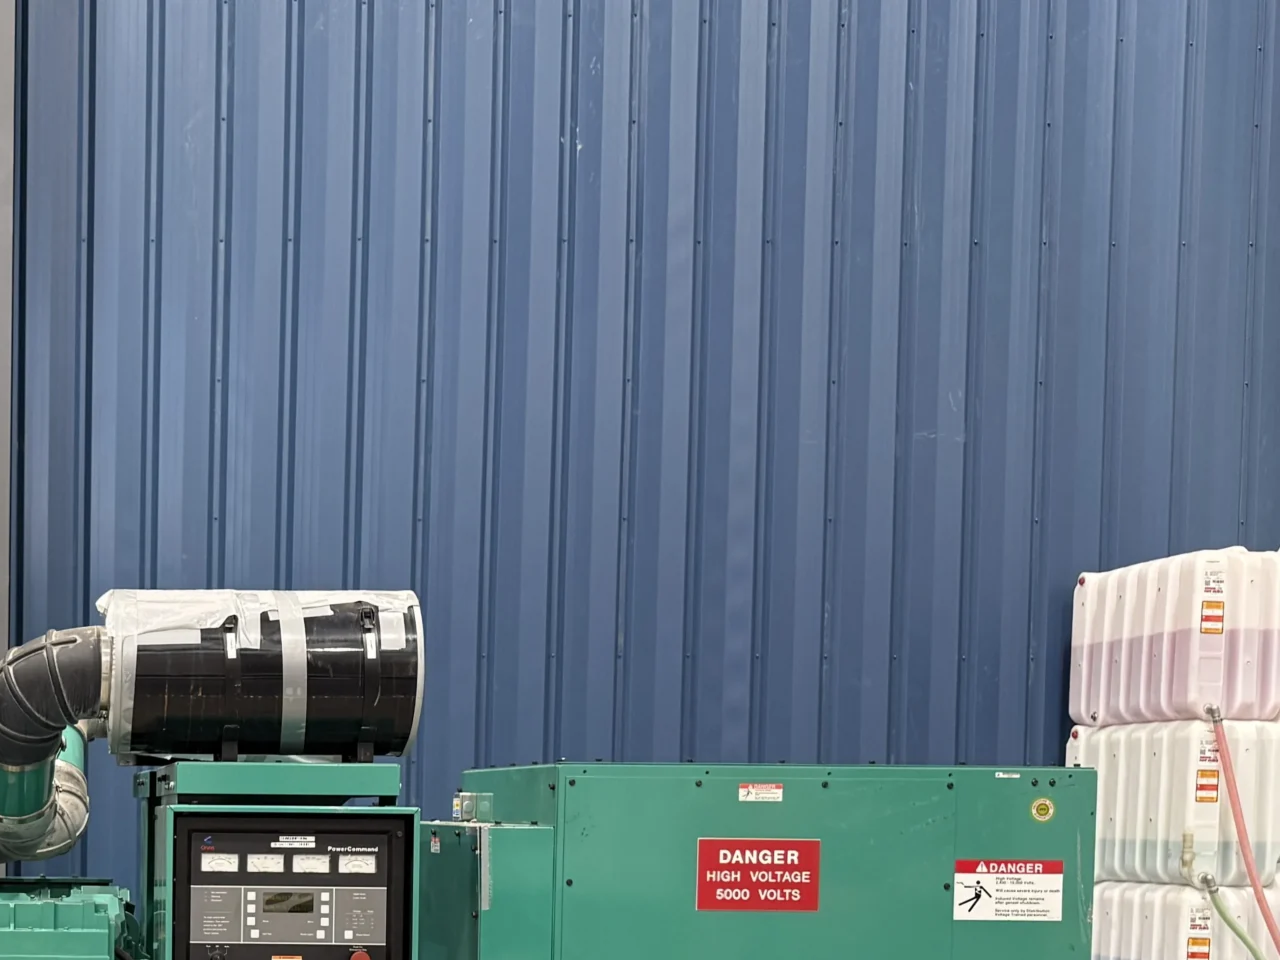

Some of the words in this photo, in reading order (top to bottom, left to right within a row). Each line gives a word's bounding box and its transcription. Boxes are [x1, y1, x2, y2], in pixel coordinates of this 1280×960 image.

[719, 849, 799, 865] DANGER
[989, 863, 1043, 873] DANGER
[706, 870, 741, 882] HIGH
[749, 870, 811, 883] VOLTAGE
[716, 888, 750, 901] 5000
[758, 889, 801, 901] VOLTS
